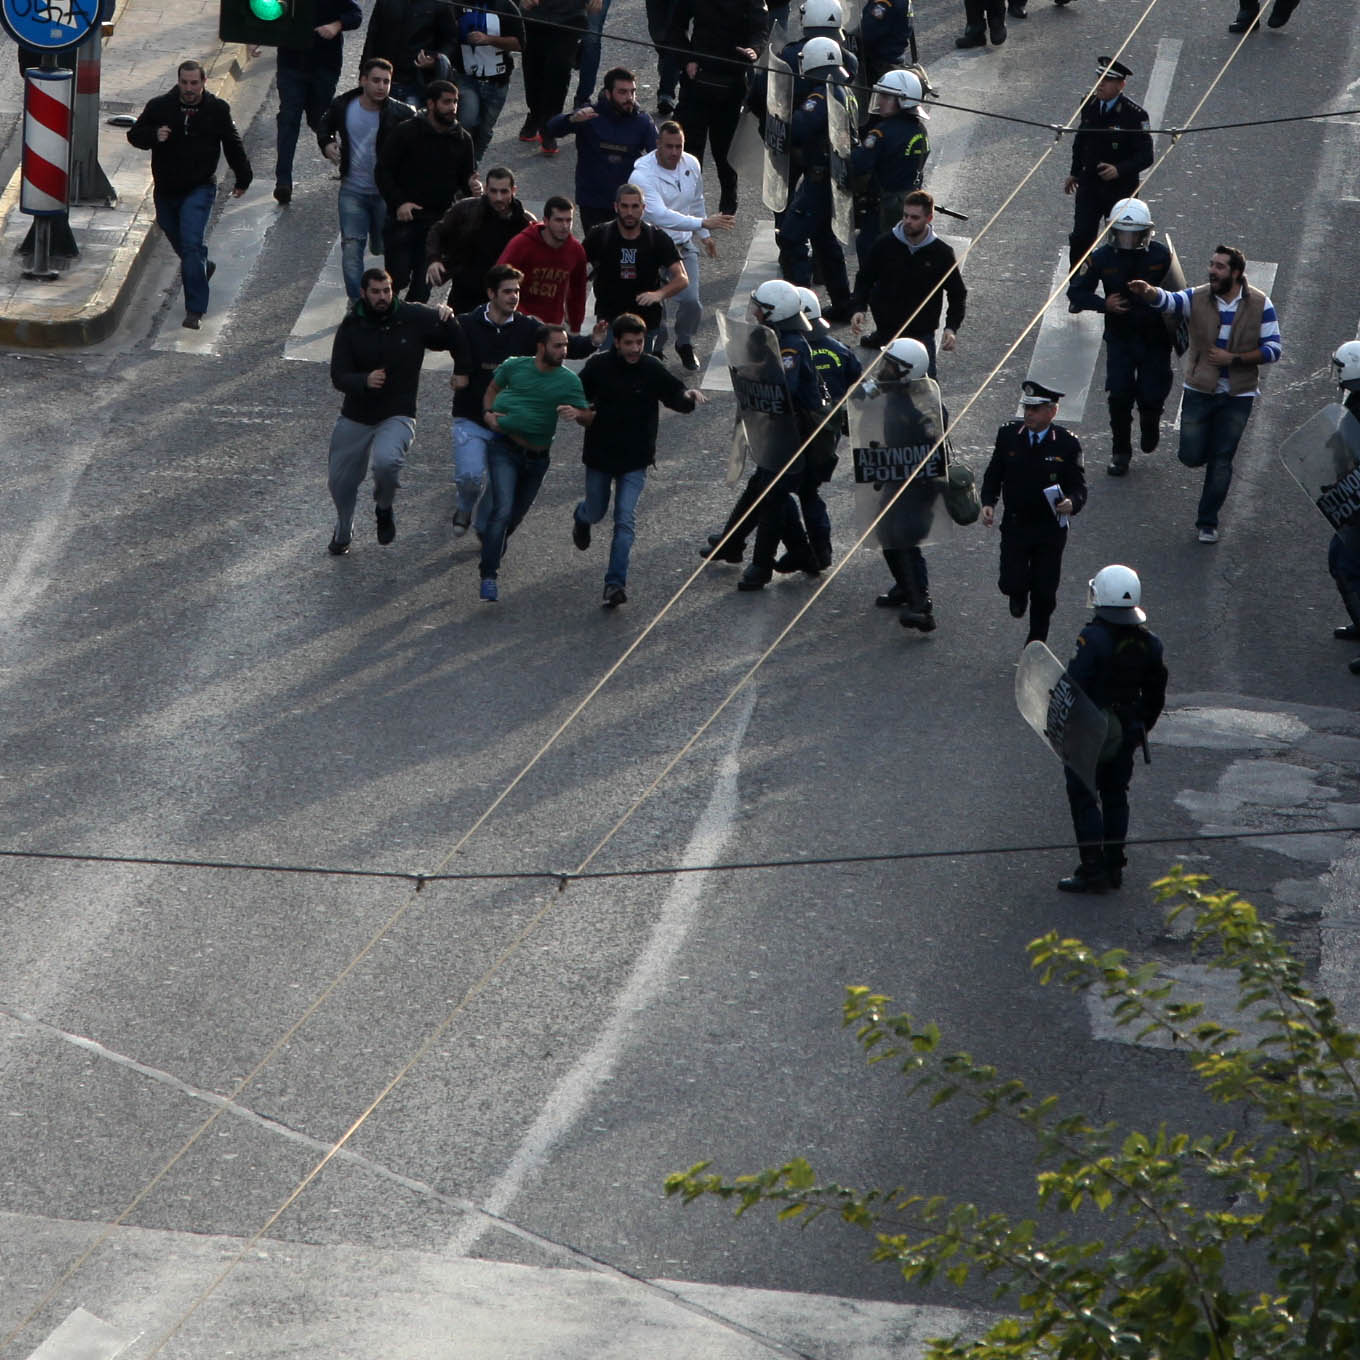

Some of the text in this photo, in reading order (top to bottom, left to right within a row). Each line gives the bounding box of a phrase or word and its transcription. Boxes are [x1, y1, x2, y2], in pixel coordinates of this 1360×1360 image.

[620, 248, 638, 264] N
[859, 444, 941, 466] ΑΣΤΥΝΟΜΙΑ
[862, 461, 938, 481] POLICE
